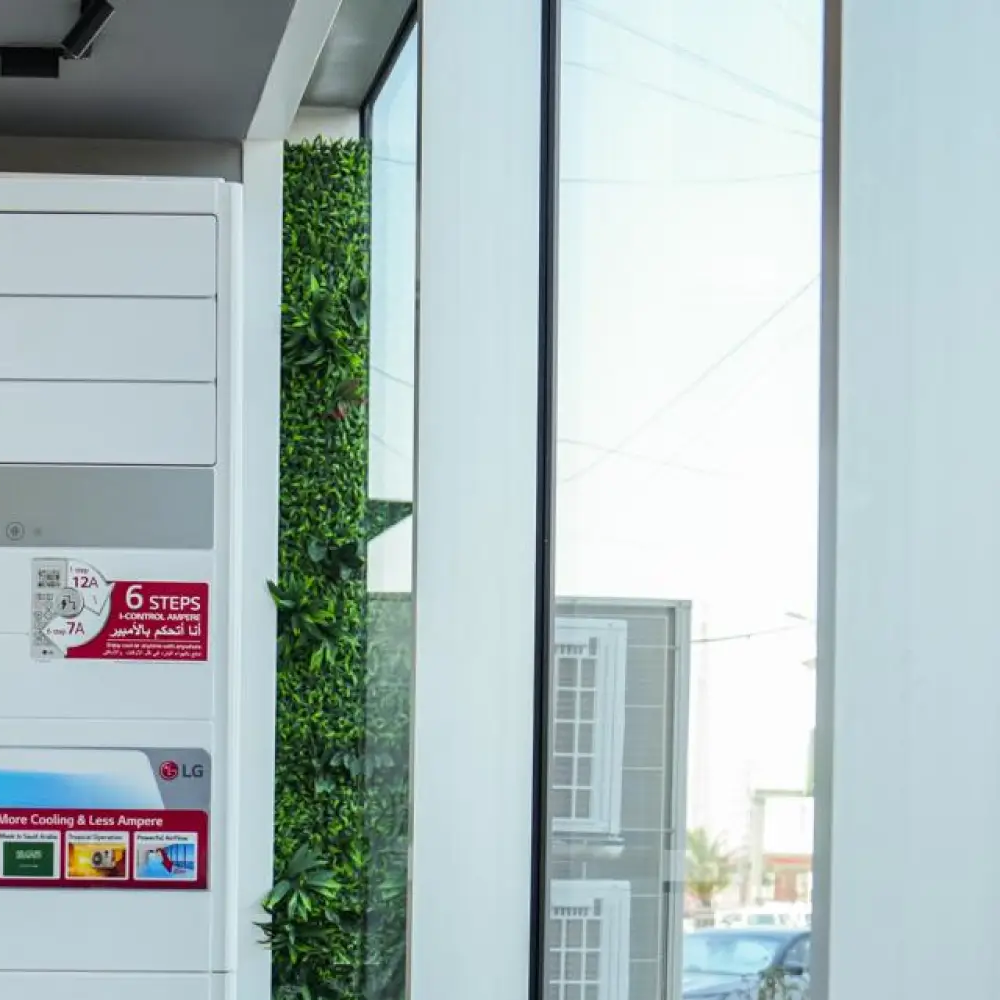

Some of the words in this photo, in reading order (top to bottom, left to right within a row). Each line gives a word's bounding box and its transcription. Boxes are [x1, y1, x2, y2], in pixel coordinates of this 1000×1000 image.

[73, 576, 99, 588] 12A
[126, 584, 144, 610] 6
[149, 596, 201, 611] STEPS
[166, 613, 201, 621] AMPERE
[66, 621, 85, 635] 7A
[108, 621, 151, 639] بالأمبير
[154, 622, 186, 640] أتحكم
[188, 622, 201, 636] أنا
[182, 763, 204, 778] LG
[30, 813, 74, 829] Cooling
[77, 814, 86, 826] &
[88, 815, 115, 826] Less
[116, 815, 164, 829] Ampere
